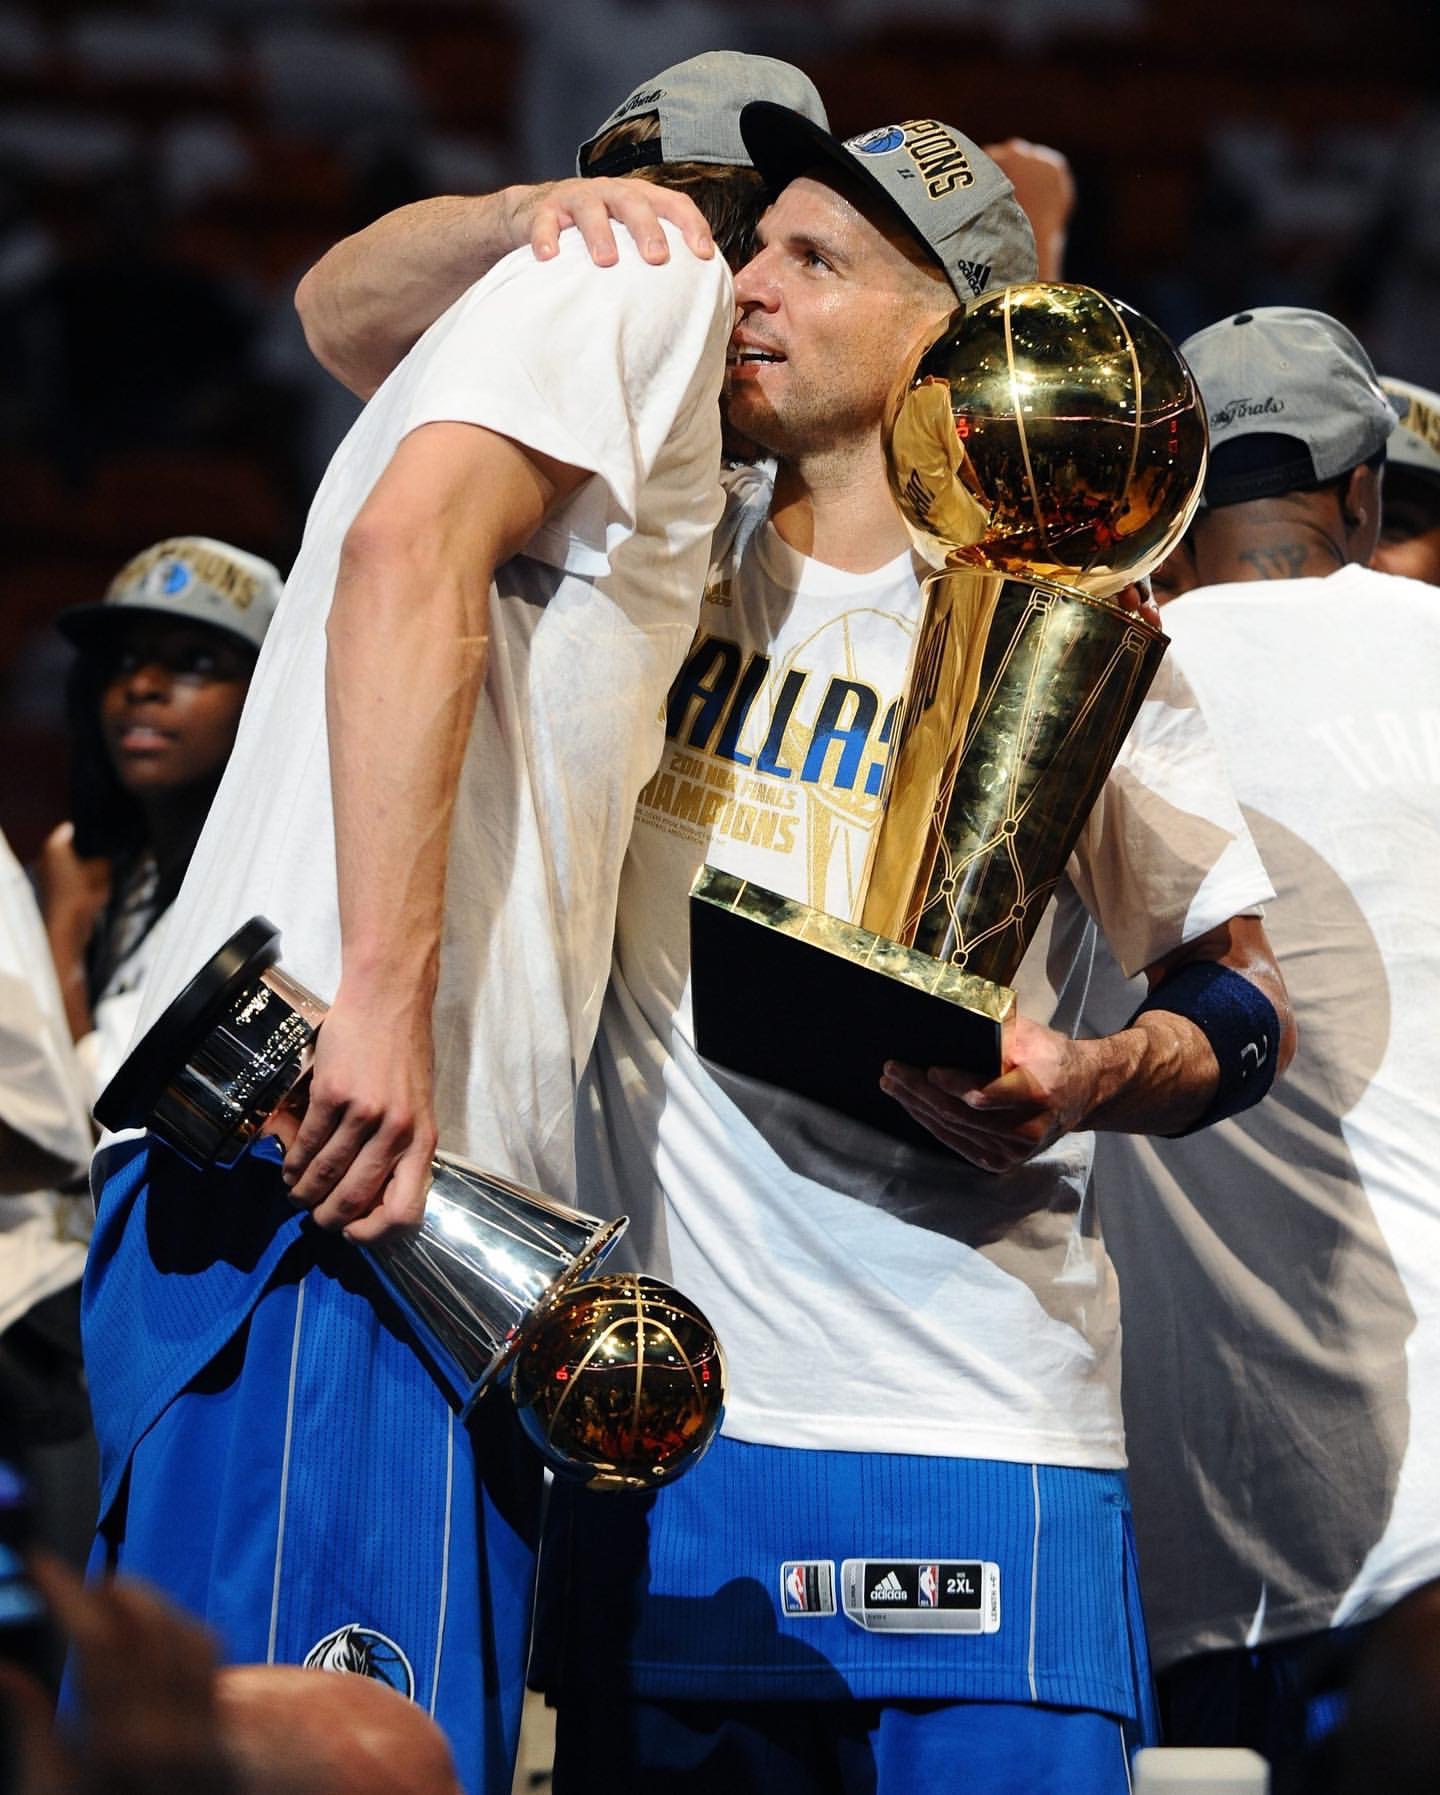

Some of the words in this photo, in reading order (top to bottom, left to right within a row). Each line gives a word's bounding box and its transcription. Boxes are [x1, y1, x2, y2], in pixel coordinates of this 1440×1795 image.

[900, 119, 975, 199] PIONS
[958, 259, 982, 298] adida
[664, 634, 904, 797] ALLA
[638, 769, 800, 854] HAMPIONS
[870, 1589, 908, 1601] adidas
[946, 1578, 975, 1594] 2XL
